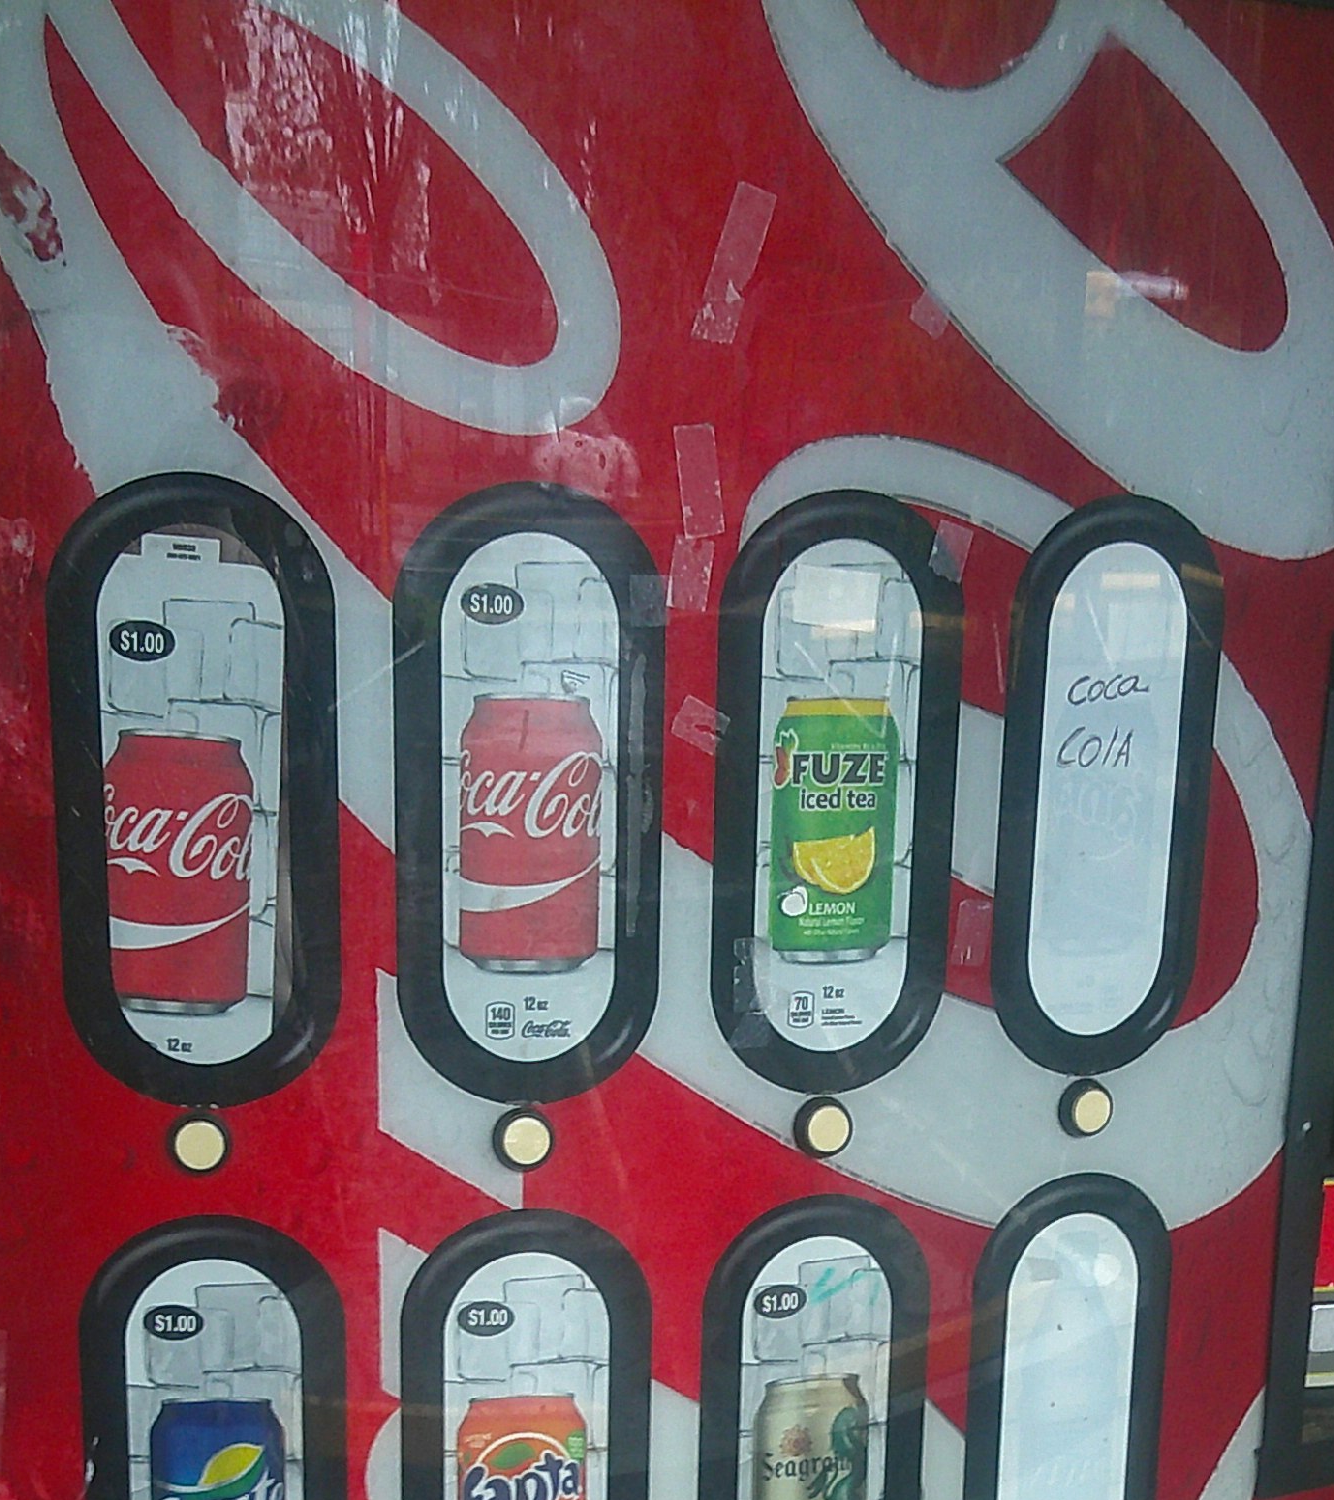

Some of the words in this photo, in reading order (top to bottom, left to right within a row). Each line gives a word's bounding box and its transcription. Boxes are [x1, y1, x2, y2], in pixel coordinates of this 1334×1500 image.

[469, 593, 513, 615] $1.00
[120, 629, 165, 654] $1.00
[790, 751, 887, 786] FUZE
[800, 787, 840, 810] iced
[847, 790, 876, 809] tea
[808, 901, 856, 916] LEMON
[490, 1007, 510, 1021] 140
[524, 996, 535, 1010] 12
[795, 996, 808, 1010] 70
[822, 986, 834, 998] 12
[167, 1038, 180, 1052] 12
[761, 1292, 799, 1313] $1.00
[155, 1314, 197, 1332] $1.00
[468, 1308, 508, 1326] $1.00
